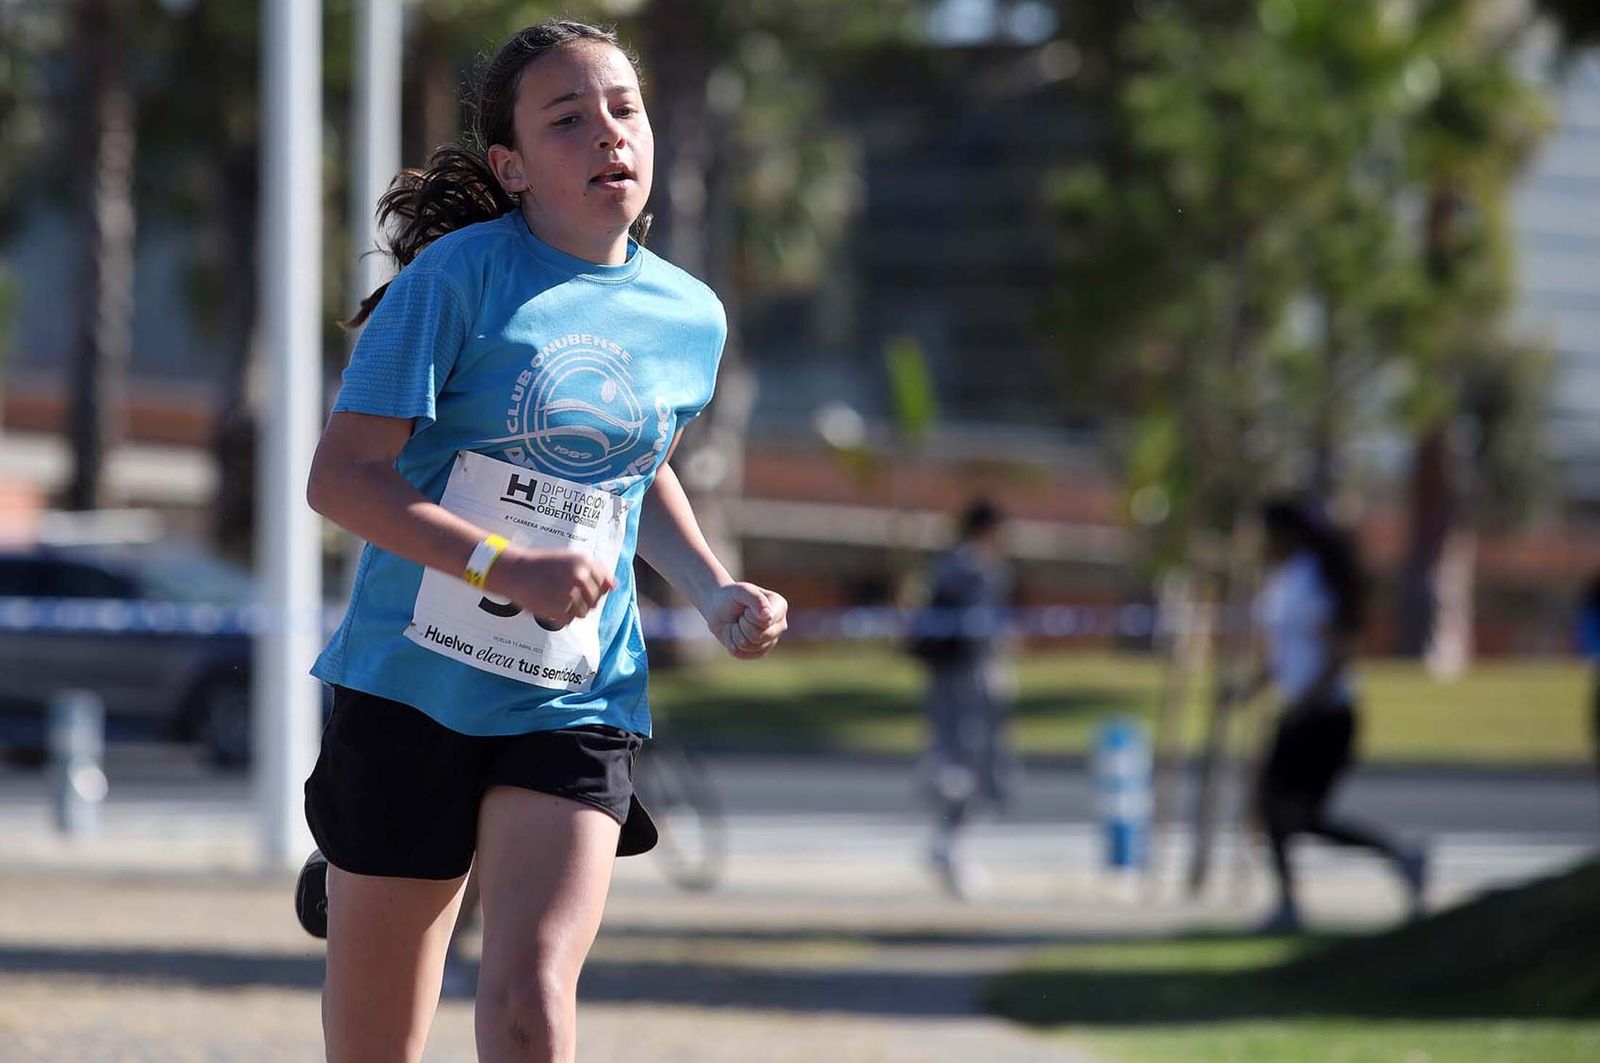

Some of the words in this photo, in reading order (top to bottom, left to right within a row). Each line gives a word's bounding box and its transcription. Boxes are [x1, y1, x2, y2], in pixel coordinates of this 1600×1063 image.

[506, 369, 532, 434] CLUB
[530, 333, 633, 369] ONUBENSE
[506, 473, 538, 502] H
[538, 494, 559, 508] DE
[562, 500, 602, 520] HUELVA
[512, 517, 539, 529] CARRERA
[539, 525, 566, 537] INFANTIL
[424, 624, 474, 656] Huelva
[475, 646, 516, 670] eleva
[518, 659, 540, 677] tus
